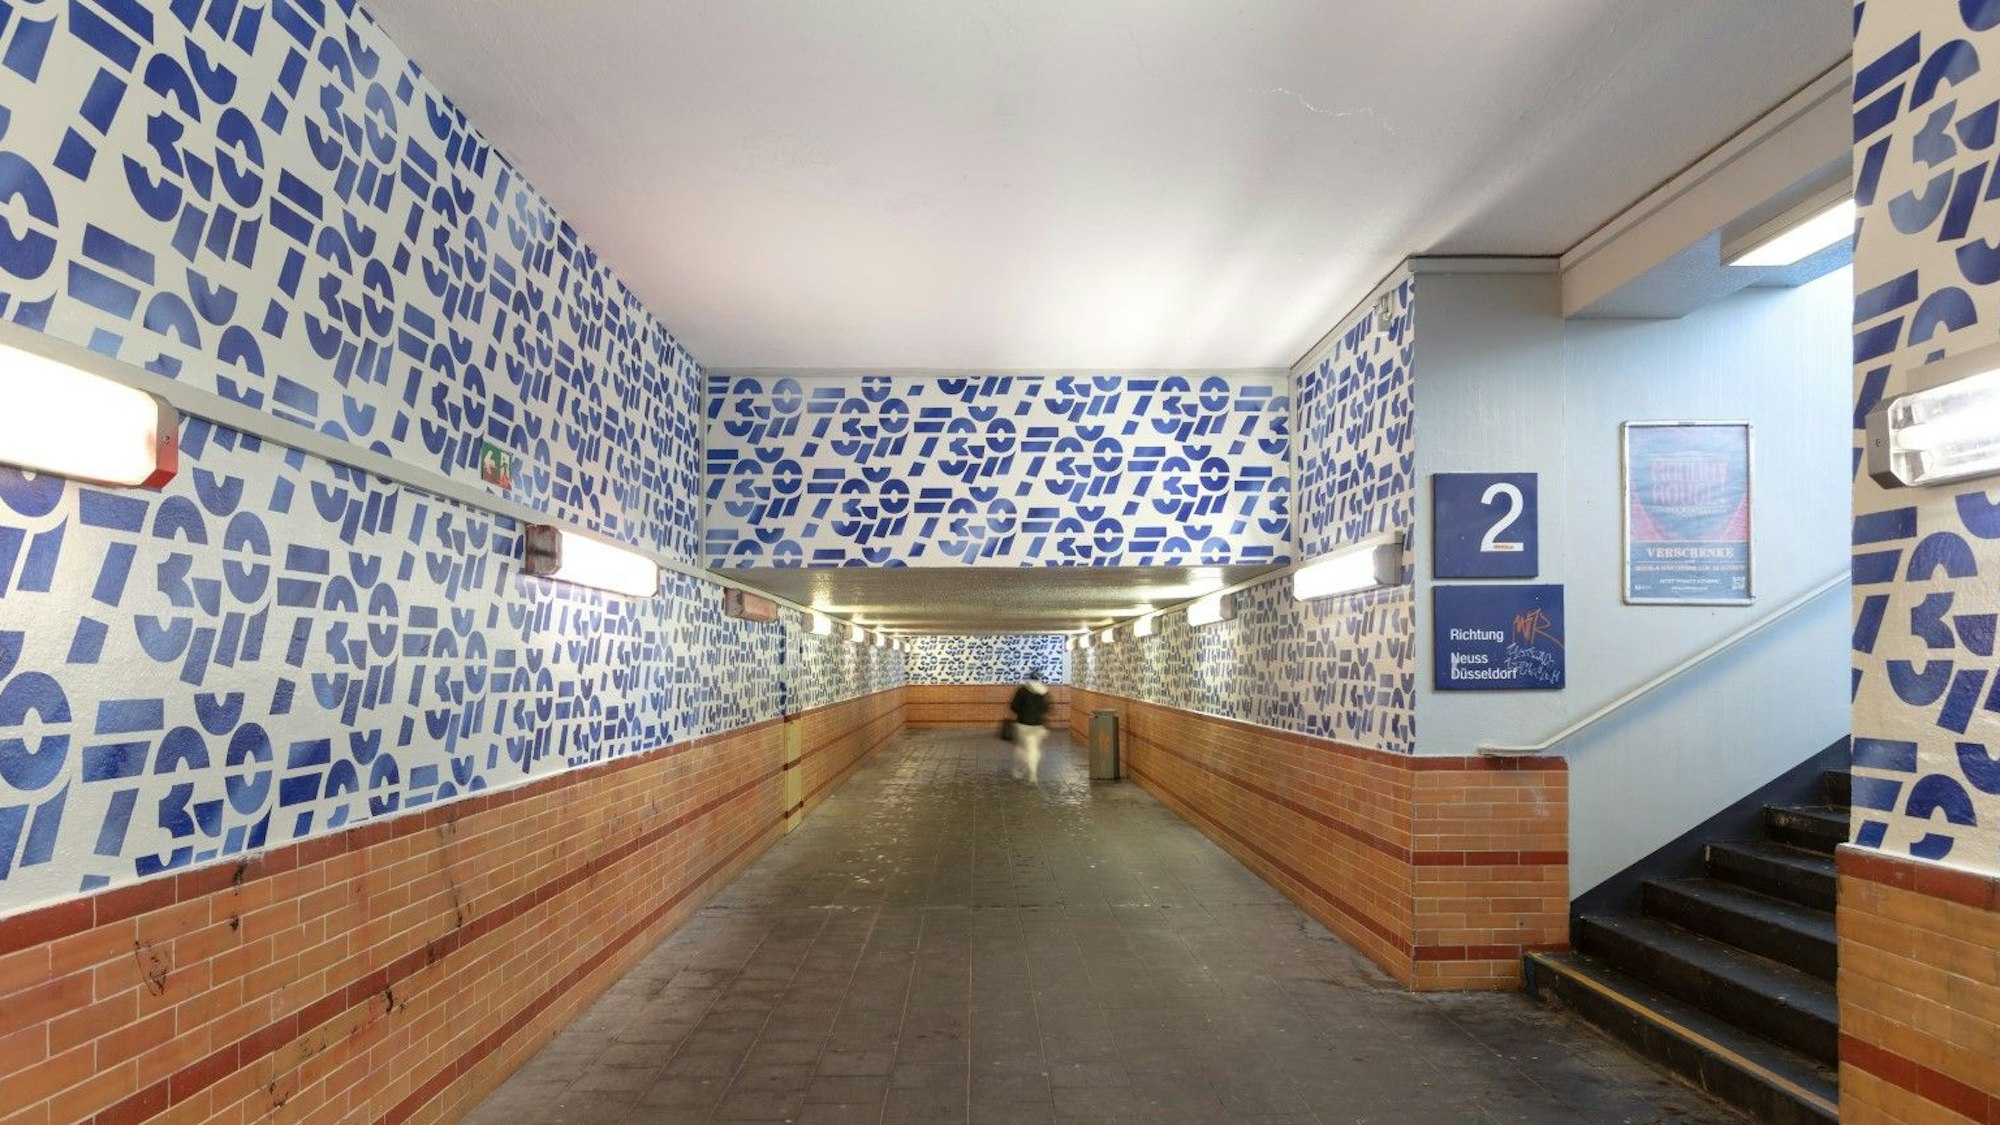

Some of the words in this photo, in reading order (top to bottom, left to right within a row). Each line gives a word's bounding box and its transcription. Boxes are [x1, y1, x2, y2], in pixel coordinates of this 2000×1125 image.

[1480, 482, 1524, 552] 2
[1646, 547, 1734, 559] VERSCHENKE
[1450, 628, 1505, 643] Richtung
[1451, 652, 1489, 664] Neuss
[1451, 667, 1518, 680] Düsseldorf
